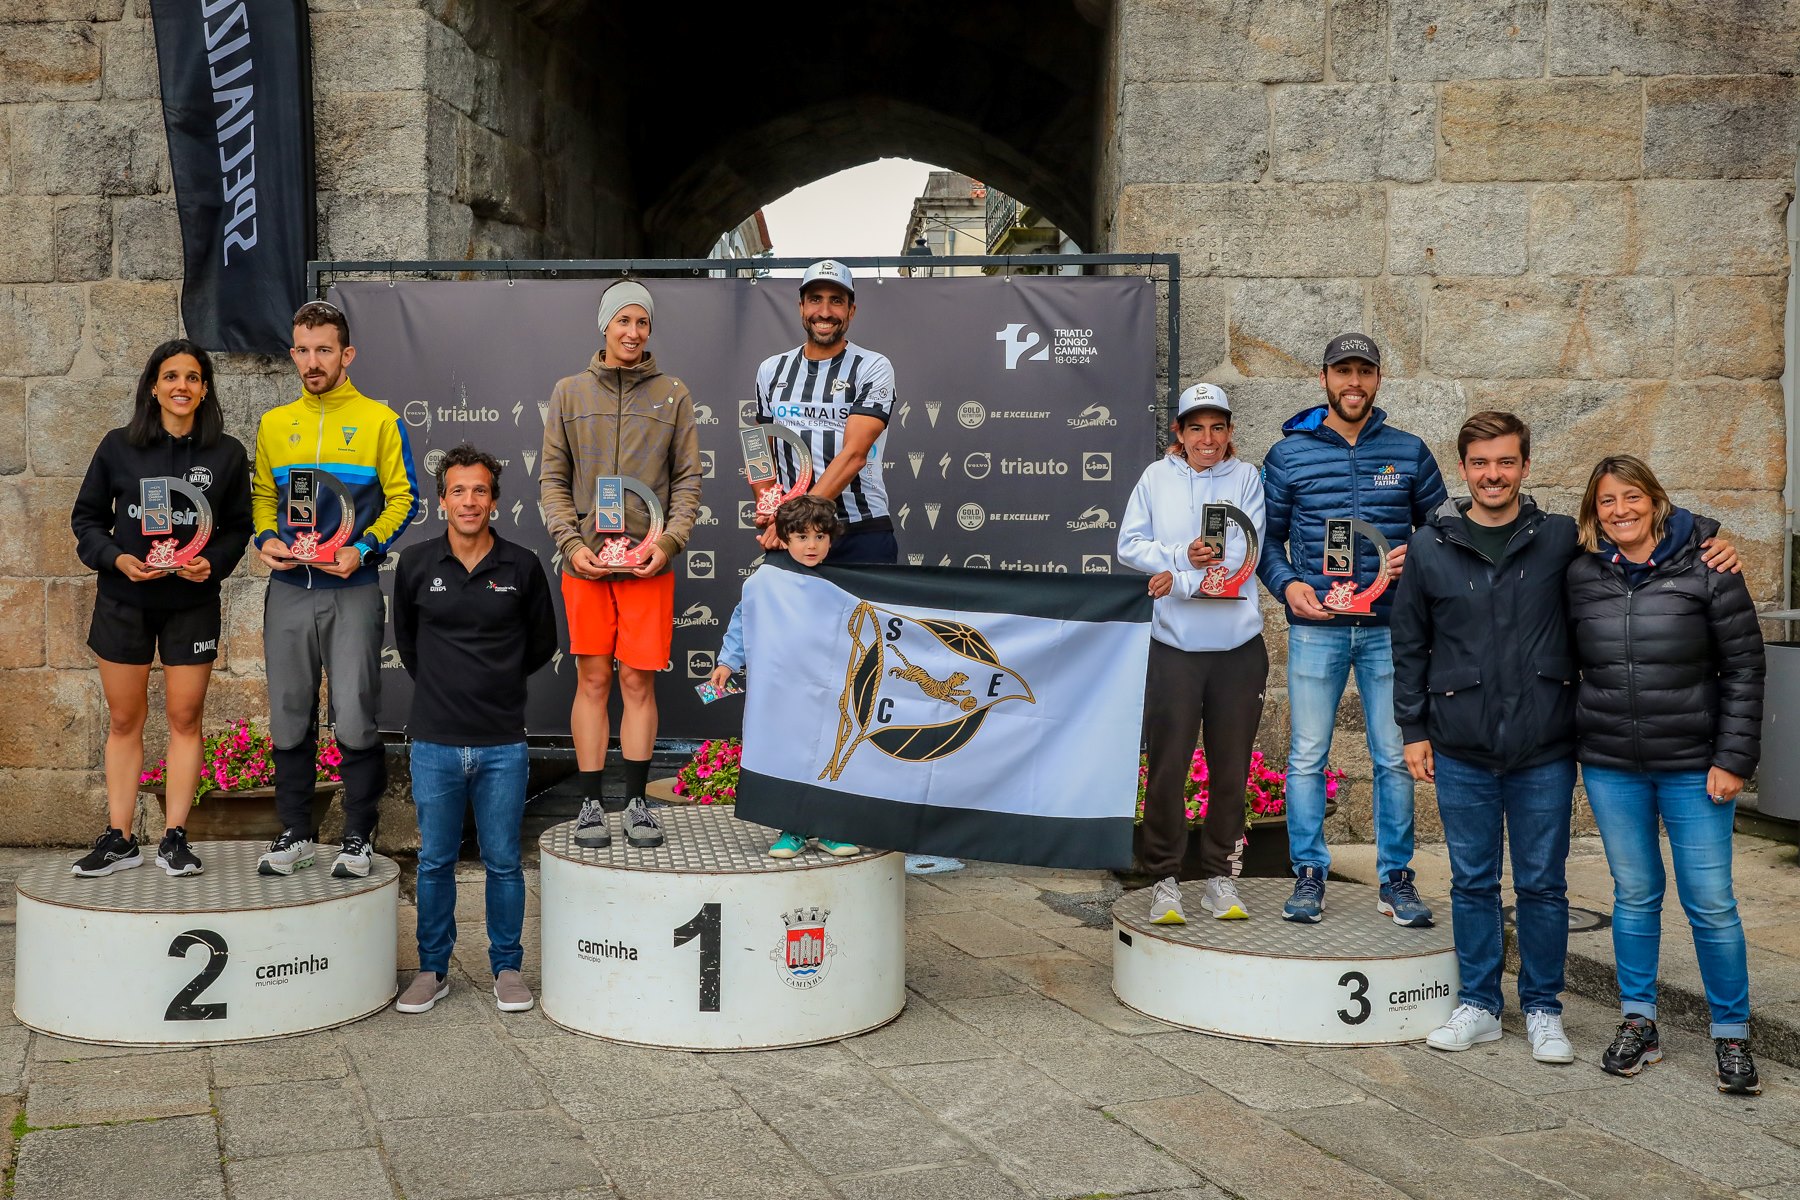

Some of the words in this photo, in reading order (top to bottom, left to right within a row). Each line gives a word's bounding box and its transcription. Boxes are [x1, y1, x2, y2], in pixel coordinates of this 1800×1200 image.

[1054, 328, 1093, 338] TRIATLO
[1054, 337, 1089, 347] LONGO
[1054, 346, 1098, 355] CAMINHA
[437, 406, 500, 422] triauto
[962, 406, 981, 414] GOLD
[990, 411, 1002, 419] BE
[1003, 411, 1051, 419] EXCELLENT
[1000, 457, 1069, 475] triauto
[1373, 473, 1400, 481] TRIATLO
[962, 508, 980, 516] GOLD
[990, 513, 1001, 521] BE
[1003, 513, 1050, 521] EXCELLENT
[886, 617, 904, 641] S
[987, 673, 1004, 697] E
[877, 698, 895, 724] C
[577, 938, 639, 961] caminha
[673, 903, 722, 1012] 1
[163, 928, 229, 1022] 2
[255, 954, 329, 980] caminha
[785, 975, 823, 989] CAMINHA
[1337, 971, 1372, 1026] 3
[1388, 980, 1450, 1005] caminha
